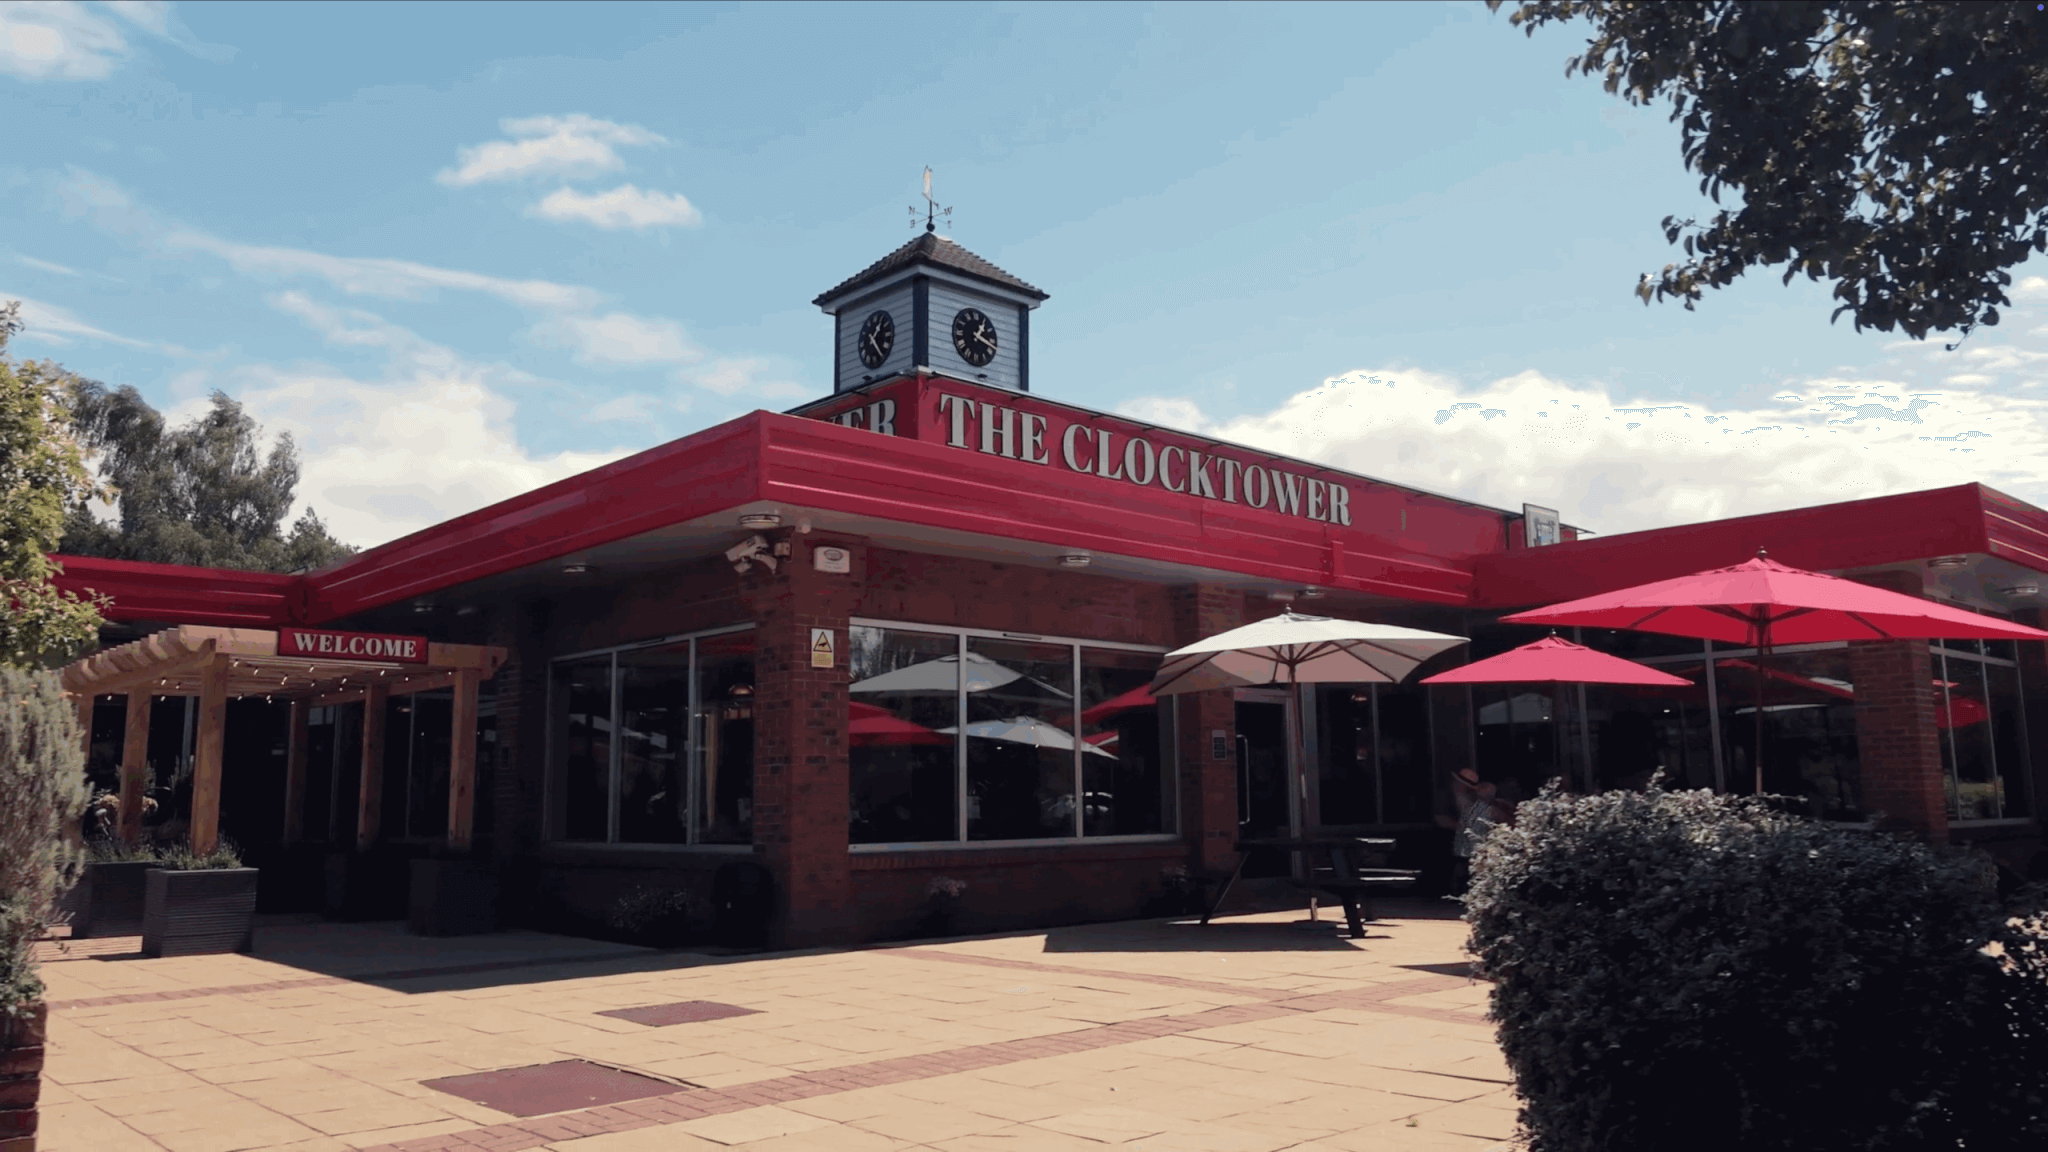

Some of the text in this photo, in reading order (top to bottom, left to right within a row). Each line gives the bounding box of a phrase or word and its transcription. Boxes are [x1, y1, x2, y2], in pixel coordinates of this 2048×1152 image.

[940, 392, 1352, 527] THE CLOCKTOWER
[293, 632, 417, 658] WELCOME
